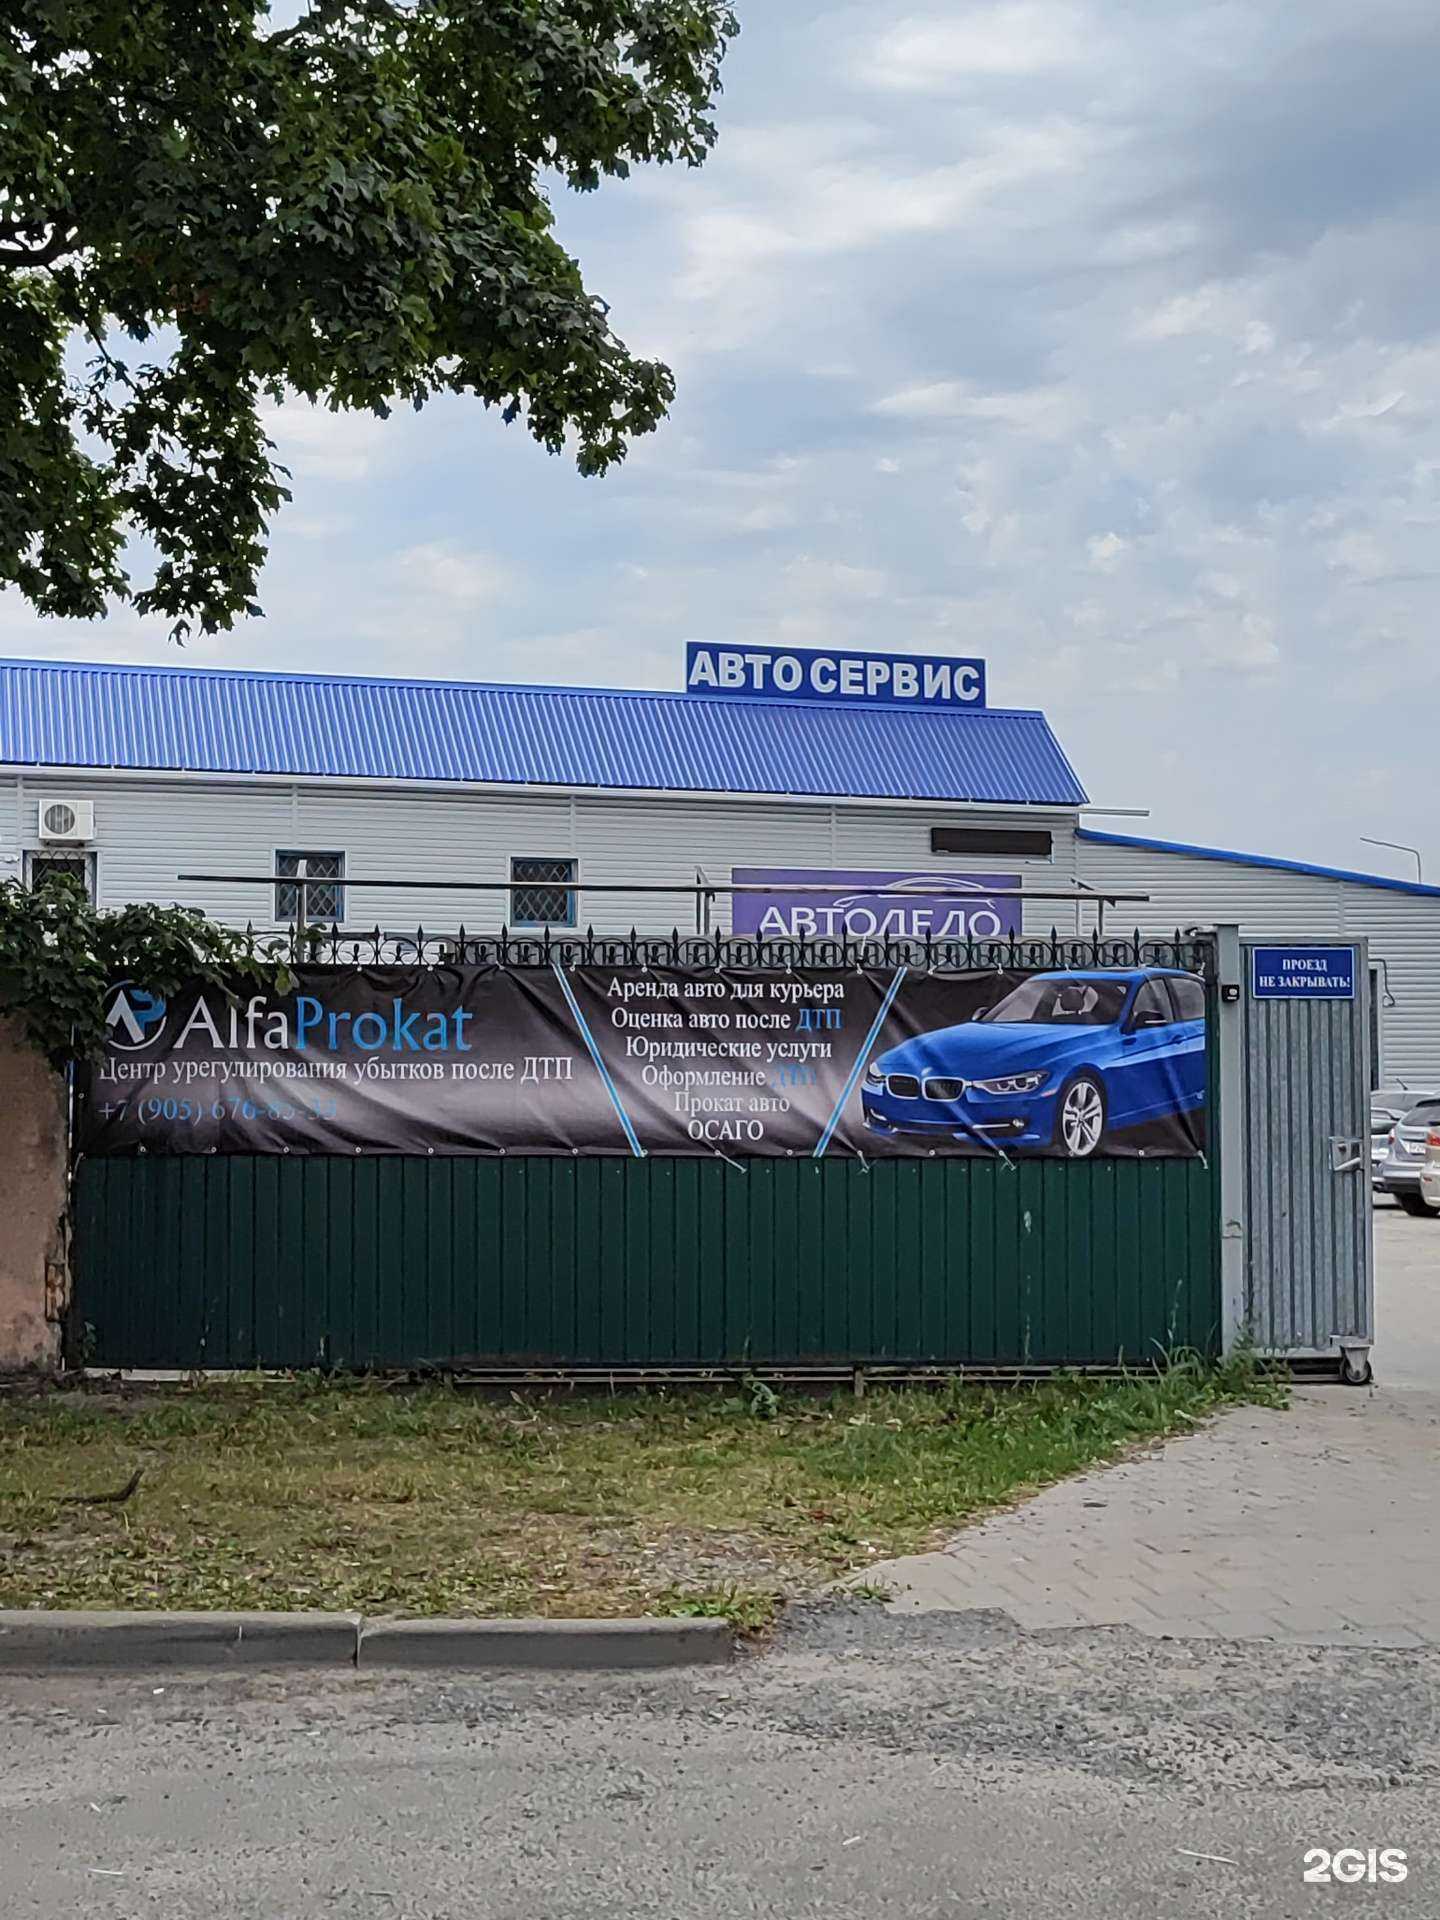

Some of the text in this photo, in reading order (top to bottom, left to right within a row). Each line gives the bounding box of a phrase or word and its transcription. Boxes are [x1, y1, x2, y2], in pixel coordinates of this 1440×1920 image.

[1282, 958, 1328, 973] ПРОЕЗД
[607, 977, 845, 1004] Аренда авто для курьера
[1259, 975, 1351, 988] НЕ ЗАКРЫВАТЬ!
[172, 994, 473, 1051] AlfaProkat
[611, 1007, 842, 1032] Оценка авто после ДТП
[625, 1036, 832, 1063] Юридические услуги
[100, 1056, 574, 1085] Центр урегулирования убытков после ДТП
[641, 1064, 766, 1090] Оформление
[99, 1099, 127, 1121] +7
[674, 1092, 791, 1117] Прокат авто
[688, 1119, 764, 1141] ОСАГО
